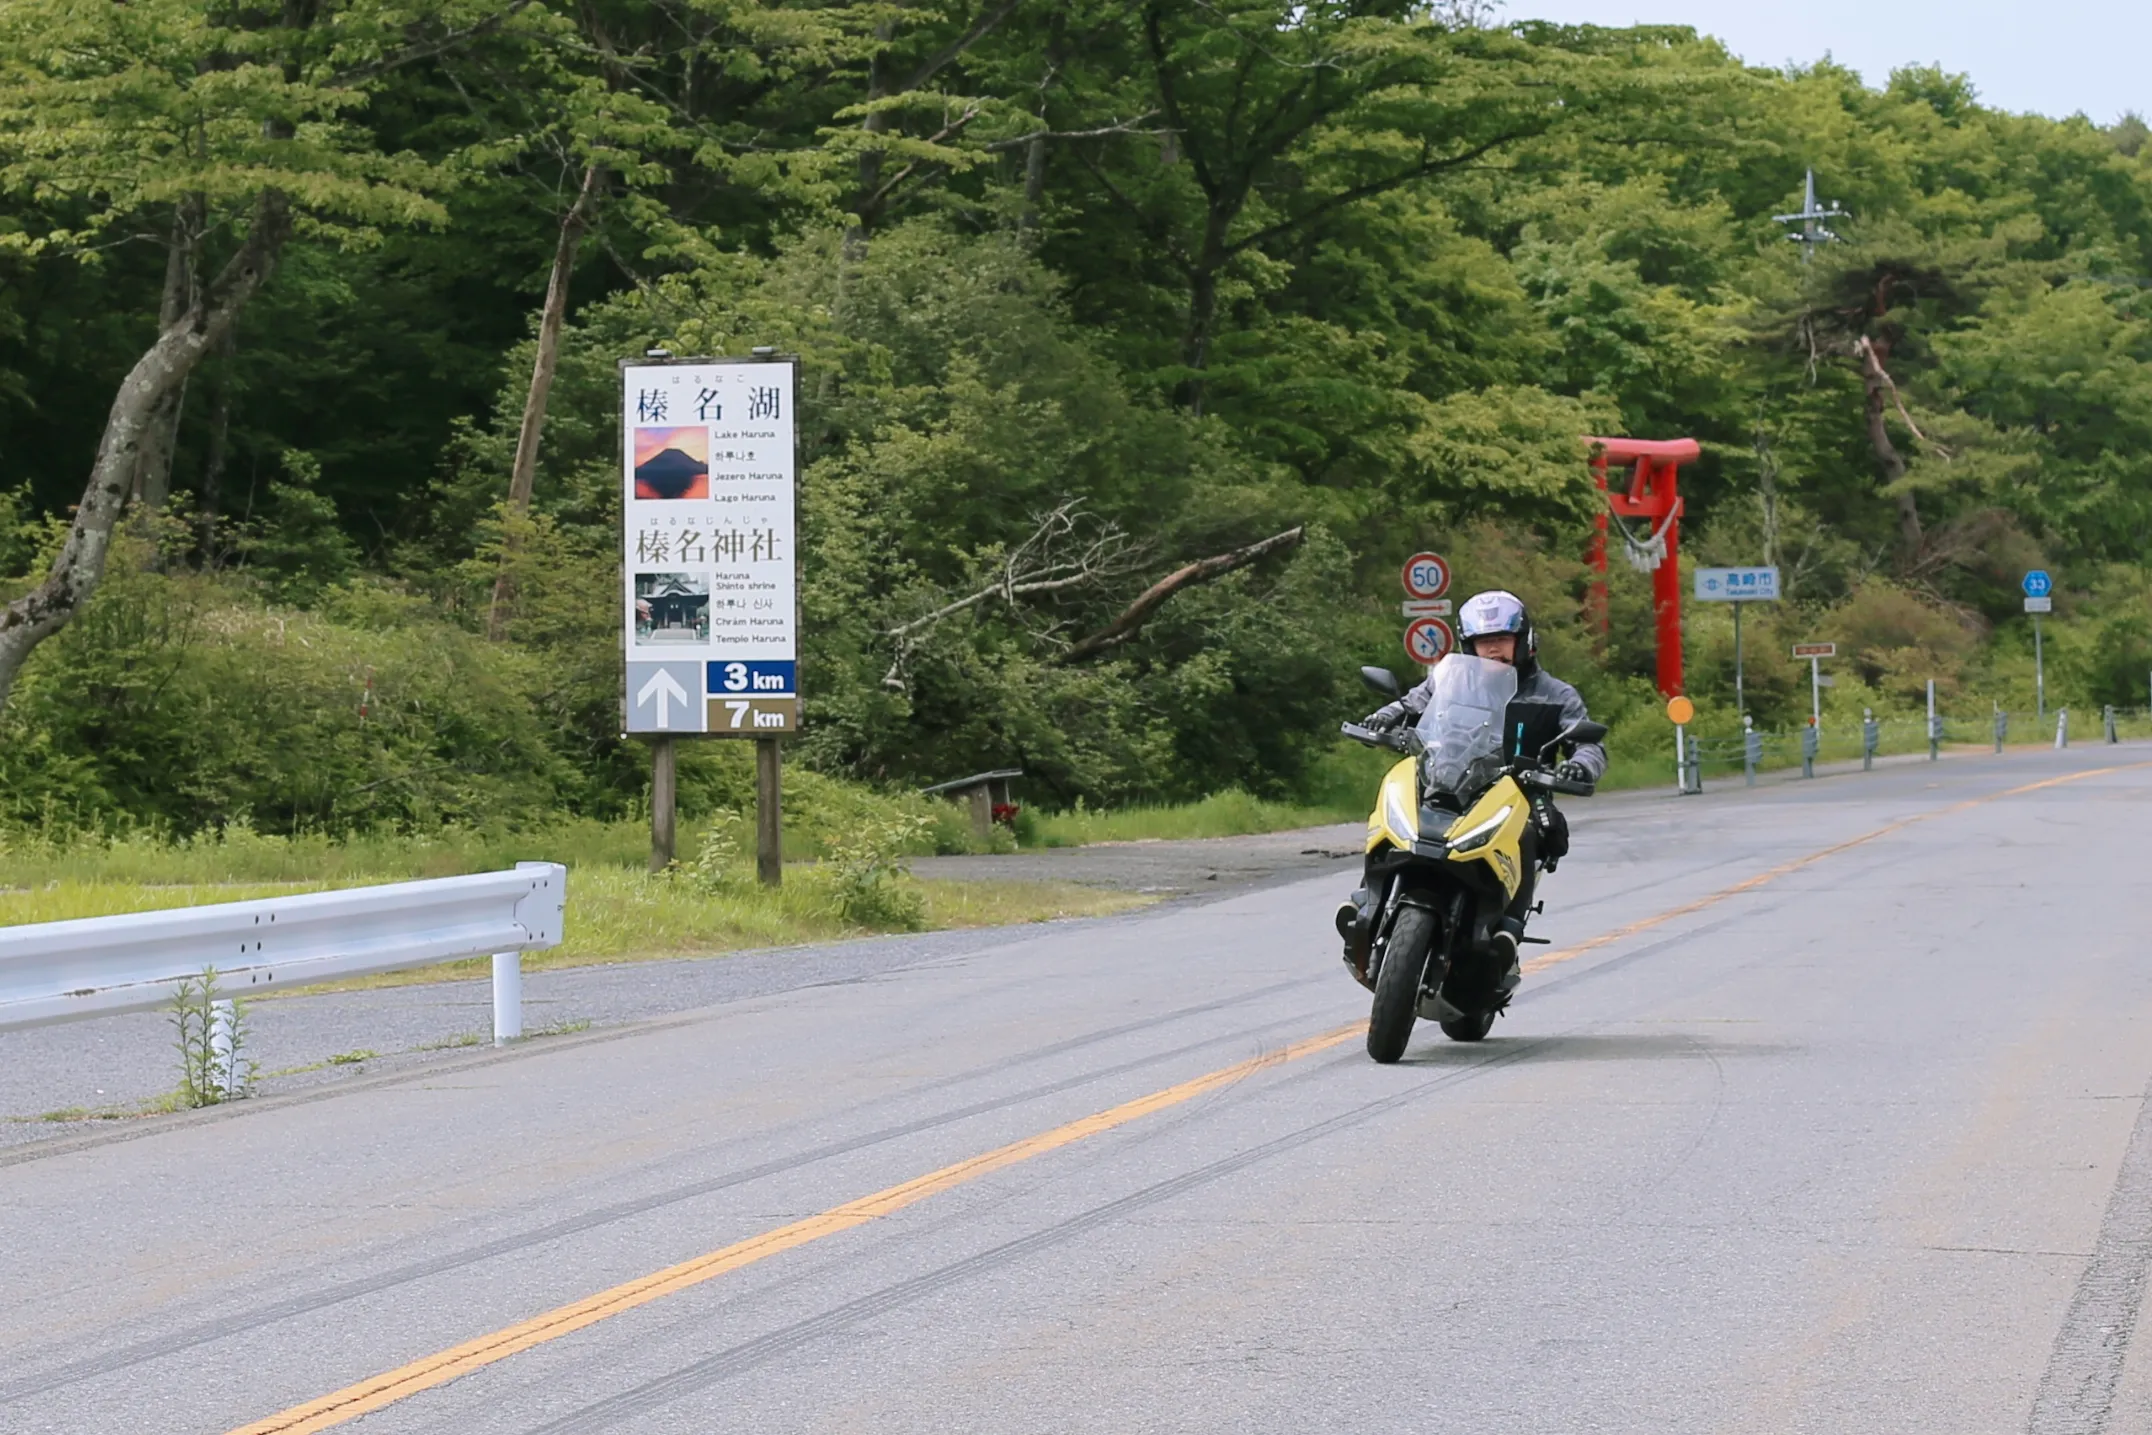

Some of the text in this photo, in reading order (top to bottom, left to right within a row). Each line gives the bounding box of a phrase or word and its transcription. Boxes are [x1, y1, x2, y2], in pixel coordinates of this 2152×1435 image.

[672, 374, 744, 384] はるなこ
[637, 387, 780, 422] 榛名湖
[715, 430, 775, 438] Lake Haruna
[715, 471, 783, 481] Jezero Haruna
[715, 493, 775, 502] Lago Haruna
[650, 516, 768, 525] はるなじんじゃ
[635, 528, 783, 564] 榛名神社
[716, 571, 750, 579] Haruna
[1413, 566, 1439, 587] 50
[1726, 573, 1772, 586] 高崎市
[716, 581, 776, 590] Shinto shrine
[716, 598, 773, 609] 하루나 신사
[750, 616, 784, 625] Haruna
[752, 634, 786, 642] Haruna
[724, 662, 784, 691] 3 km
[725, 701, 784, 728] 7 km
